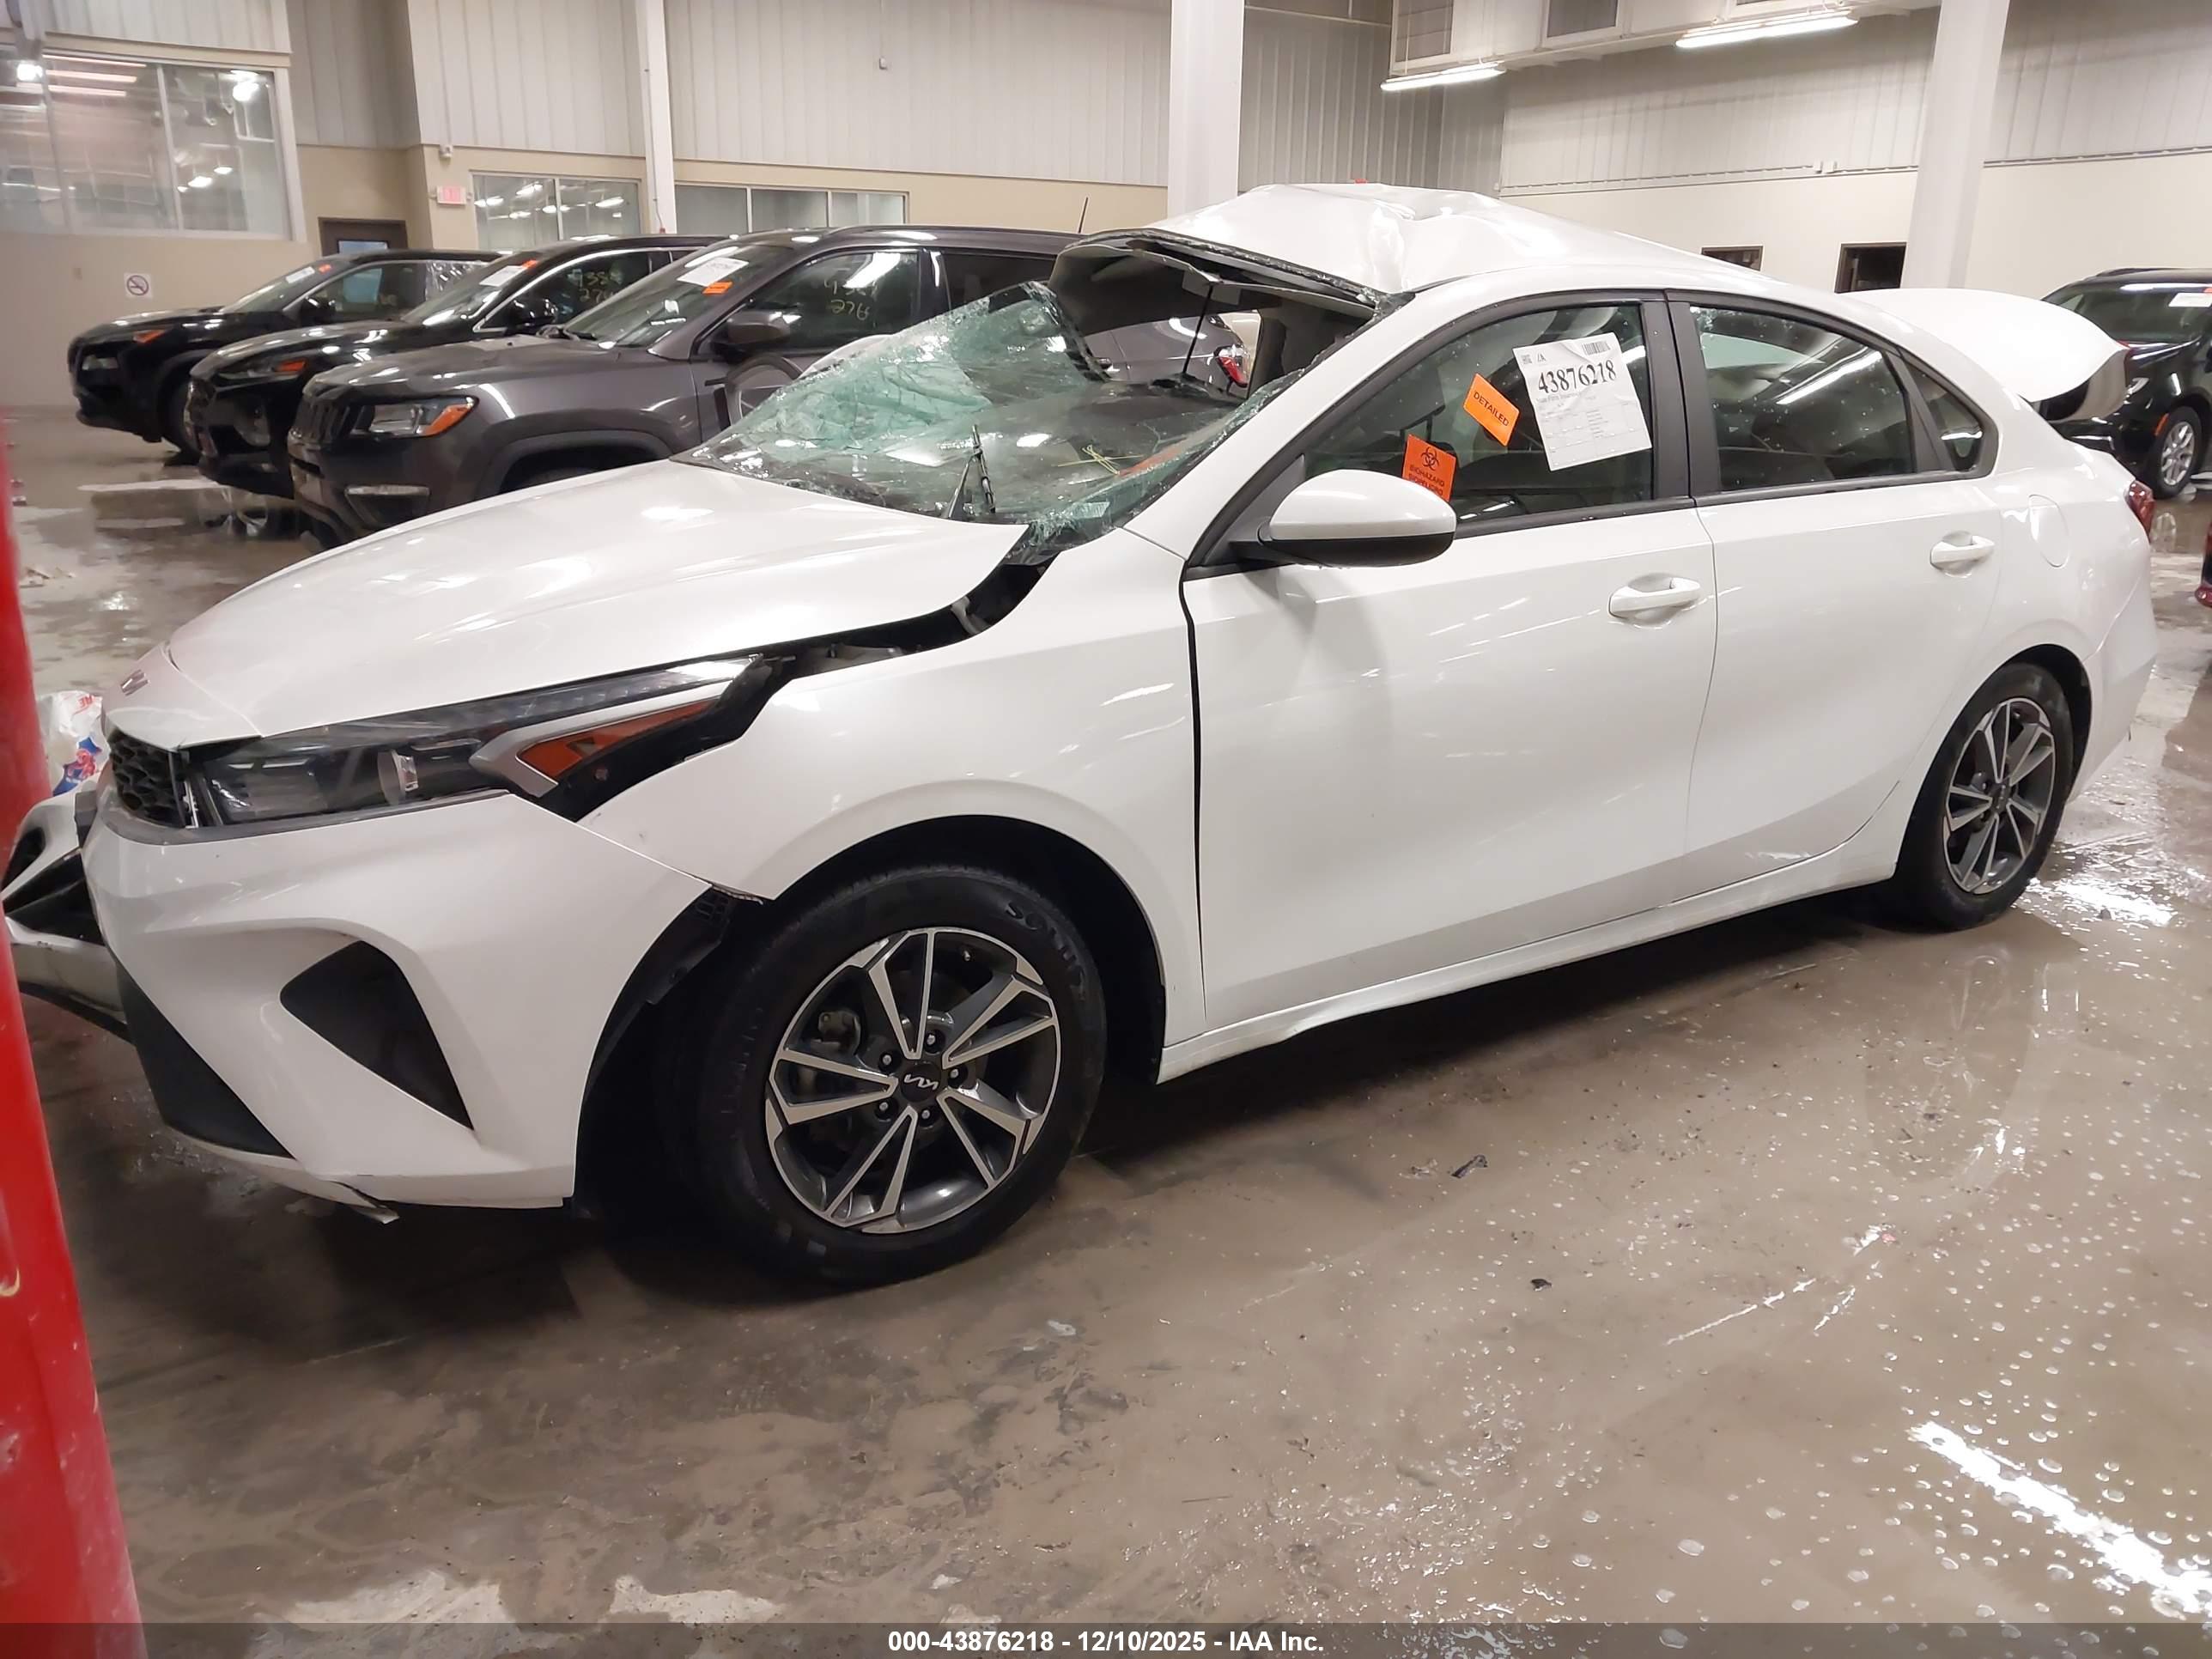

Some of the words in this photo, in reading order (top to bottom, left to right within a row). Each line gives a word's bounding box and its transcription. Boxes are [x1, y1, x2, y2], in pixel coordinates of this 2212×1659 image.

[1538, 359, 1617, 393] 43876218
[1473, 392, 1510, 427] DETAILED
[1408, 465, 1445, 488] BIOHAZARD
